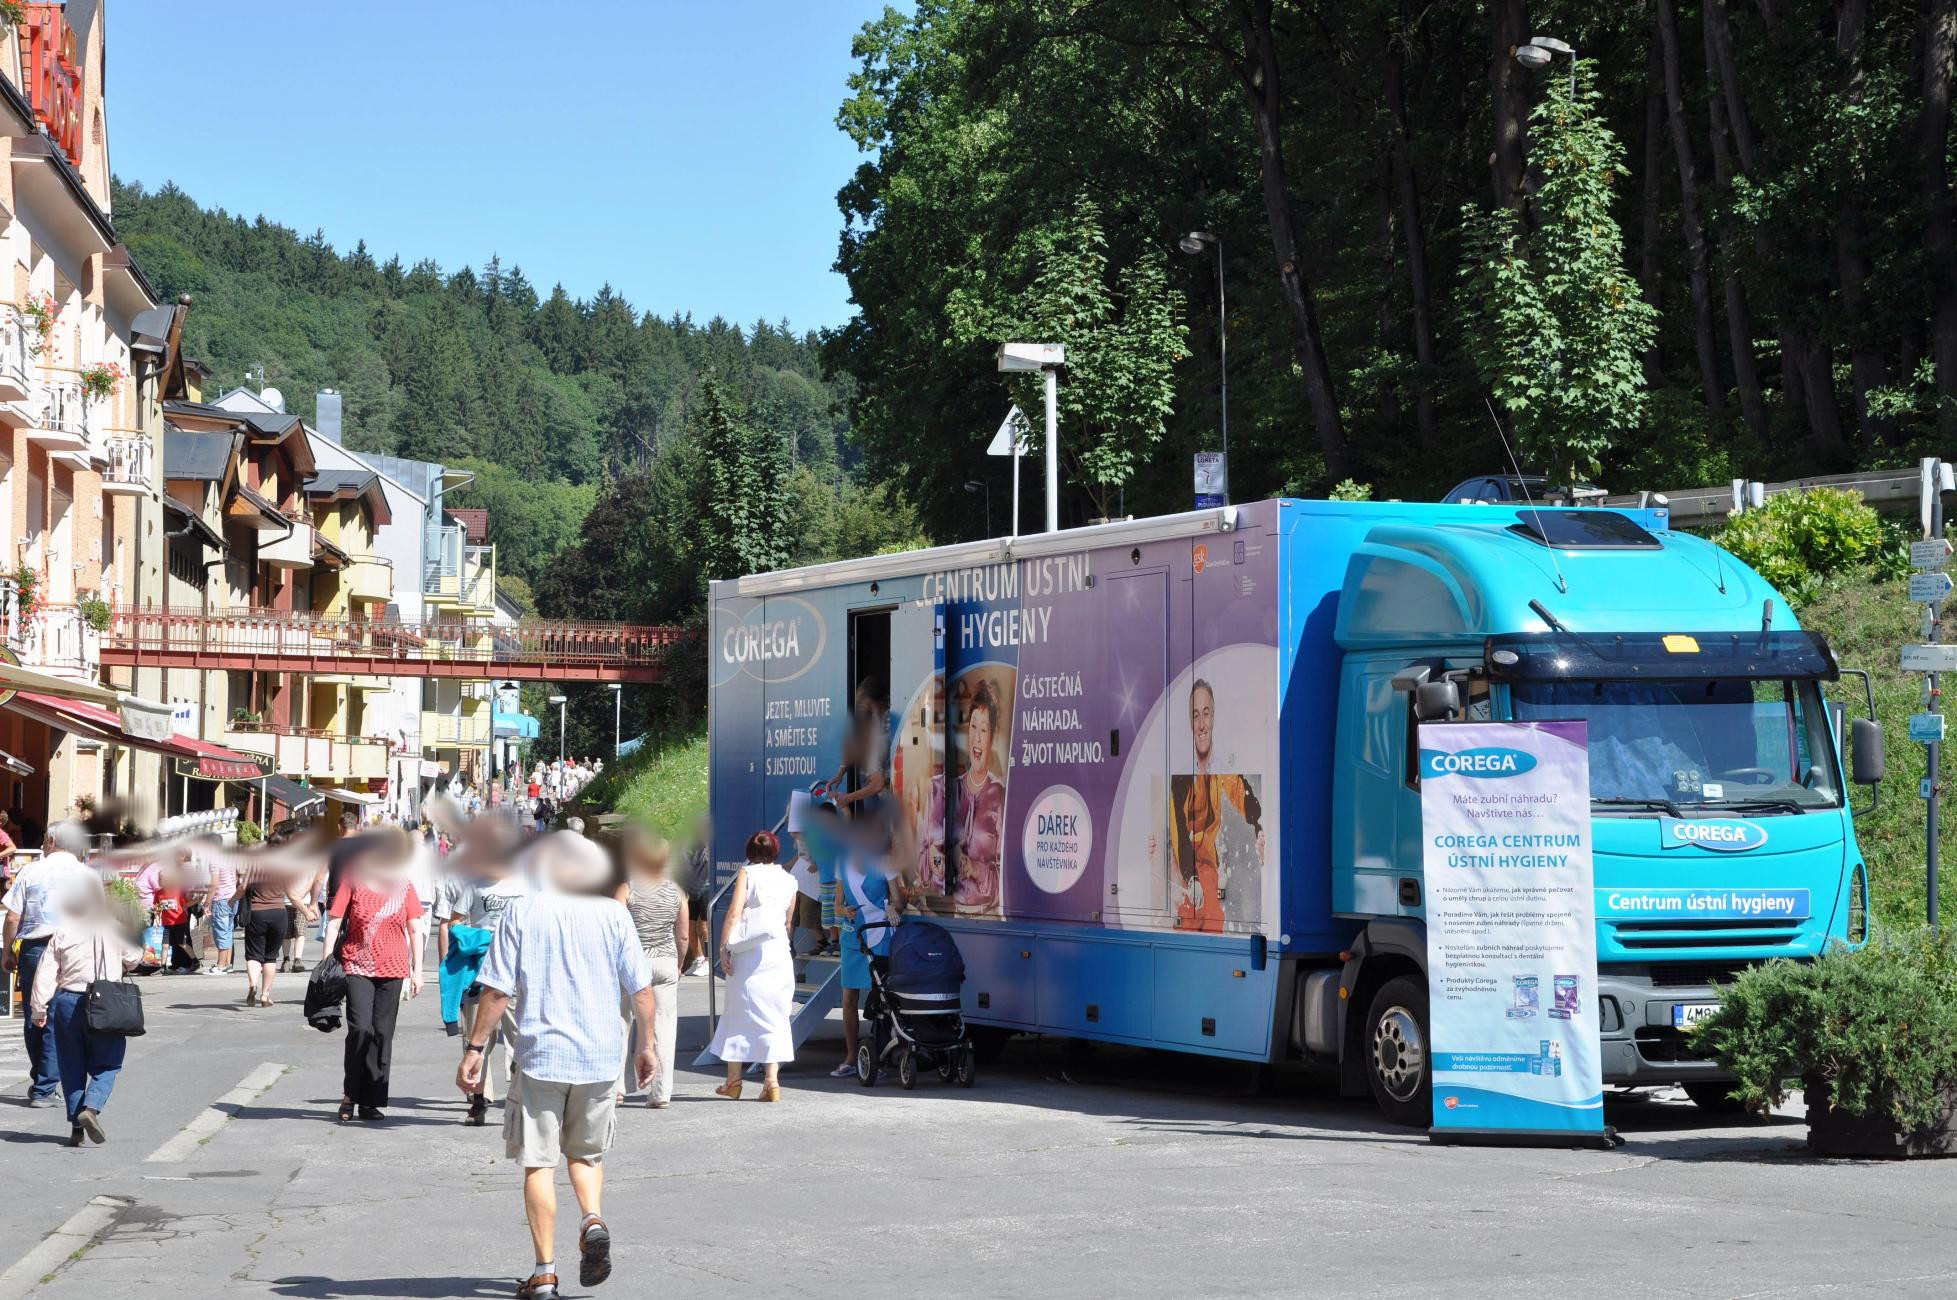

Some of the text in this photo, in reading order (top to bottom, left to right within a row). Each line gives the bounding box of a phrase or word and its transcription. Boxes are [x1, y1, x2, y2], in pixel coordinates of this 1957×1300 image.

[918, 561, 1018, 606] CENTRUM
[961, 606, 1053, 649] HYGIENY
[723, 618, 800, 664] COREGA
[1022, 671, 1083, 699] ČÁSTEČNÁ
[765, 698, 831, 720] JEZTE, MLUVTE
[1022, 707, 1083, 732] NÁHRADA.
[766, 727, 818, 748] A SMĚJTE SE
[1022, 741, 1105, 766] ŽIVOT NAPLNO.
[766, 756, 816, 776] S JISTOTOU!
[1431, 754, 1517, 772] COREGA
[1453, 793, 1558, 804] Máte zubní náhradu?
[1038, 811, 1078, 837] DÁREK
[1673, 823, 1747, 842] COREGA
[1037, 841, 1078, 854] PRO KAŽDÉHO
[1434, 834, 1581, 848] COREGA CENTRUM
[1037, 857, 1078, 870] NÁVŠTĚVNÍKA
[1448, 853, 1568, 868] ÚSTNÍ HYGIENY
[1469, 895, 1487, 903] chrup
[1511, 887, 1522, 895] jak
[1523, 886, 1547, 895] správně
[1548, 886, 1574, 895] pečovat
[1608, 893, 1795, 914] Centrum ústní hygieny
[1490, 912, 1499, 920] jak
[1515, 911, 1546, 920] problémy
[1494, 920, 1519, 928] náhrady
[1446, 977, 1498, 985] Produkty Corega
[1455, 986, 1497, 994] zvýhodněnou
[1493, 1055, 1526, 1063] odměníme
